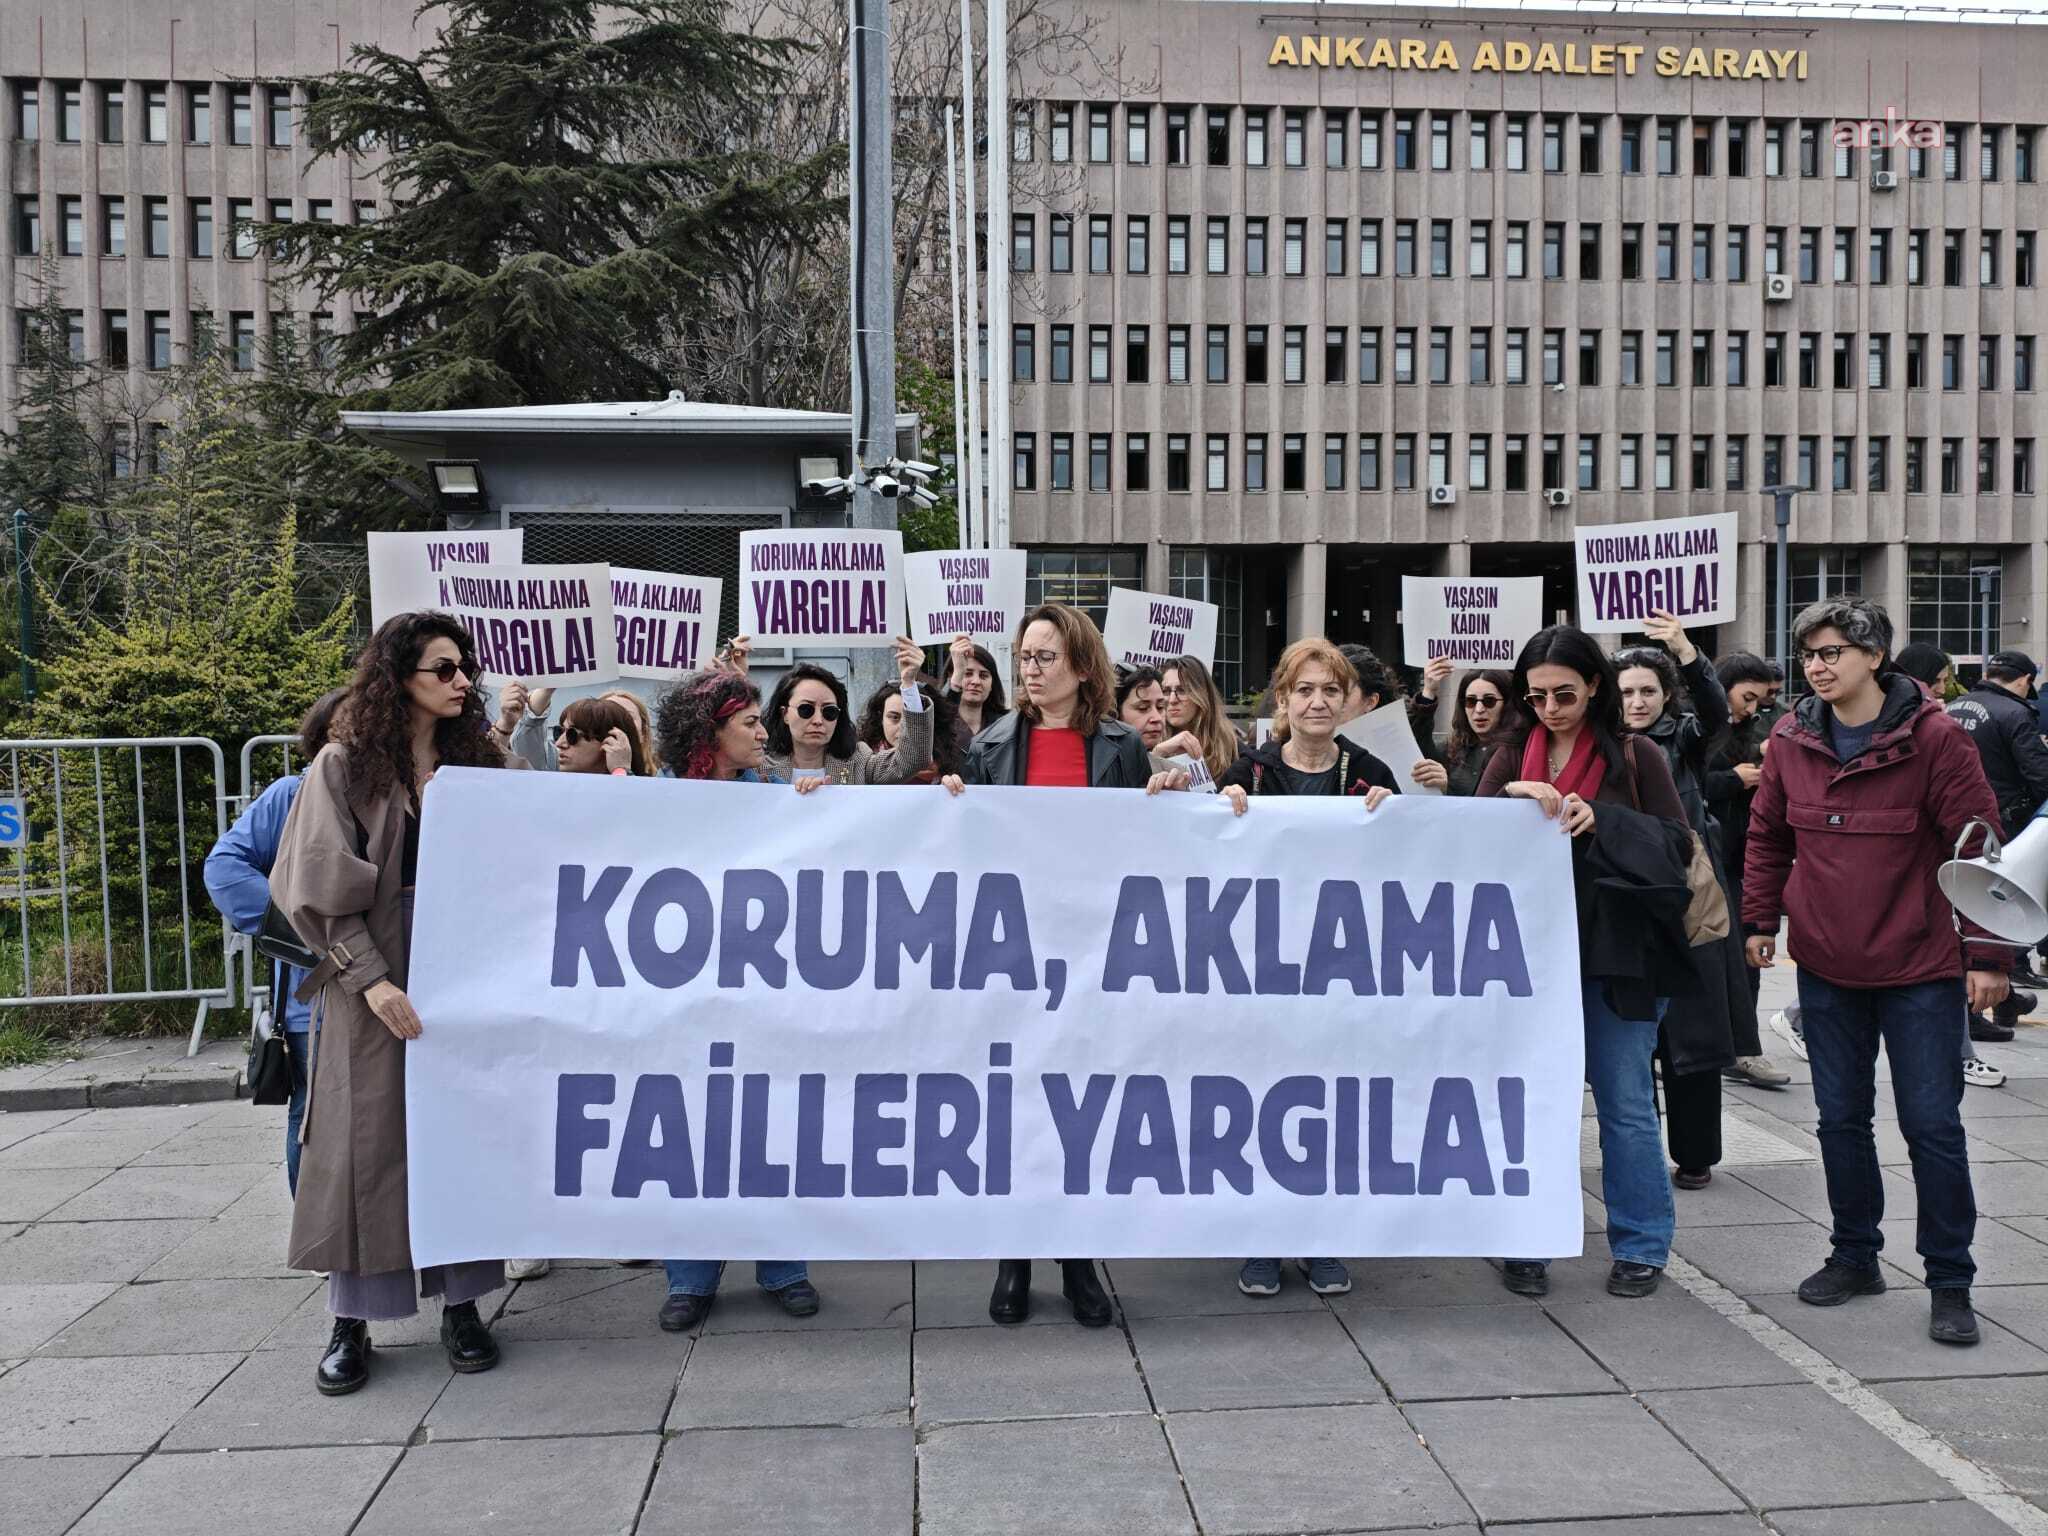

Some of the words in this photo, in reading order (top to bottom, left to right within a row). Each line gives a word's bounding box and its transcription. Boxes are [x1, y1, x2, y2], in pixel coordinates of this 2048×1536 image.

[1268, 35, 1460, 70] ANKARA
[1471, 41, 1644, 75] ADALET
[1655, 46, 1808, 79] SARAYI
[751, 542, 817, 571] KORUMA
[821, 542, 886, 571] AKLAMA
[1586, 535, 1650, 564] KORUMA
[1654, 528, 1719, 560] AKLAMA
[939, 557, 990, 583] YAŞASIN
[451, 576, 514, 610] KORUMA
[517, 579, 590, 610] AKLAMA
[641, 583, 702, 614] AKLAMA
[947, 584, 984, 606] KADIN
[1444, 586, 1498, 612] YAŞASIN
[1588, 562, 1719, 620] YARGILA!
[751, 579, 887, 634] YARGILA!
[1149, 602, 1194, 630] YAŞASIN
[928, 610, 1005, 636] DAYANIŞMASI
[1451, 613, 1490, 635] KADIN
[614, 614, 700, 669] RGILA!
[1149, 630, 1185, 655] KADIN
[1428, 639, 1514, 663] DAYANIŞMASI
[551, 864, 1067, 1011] KORUMA,
[1102, 876, 1533, 998] AKLAMA
[554, 1042, 1013, 1199] FAİLLERİ
[1040, 1073, 1530, 1197] YARGILA!
